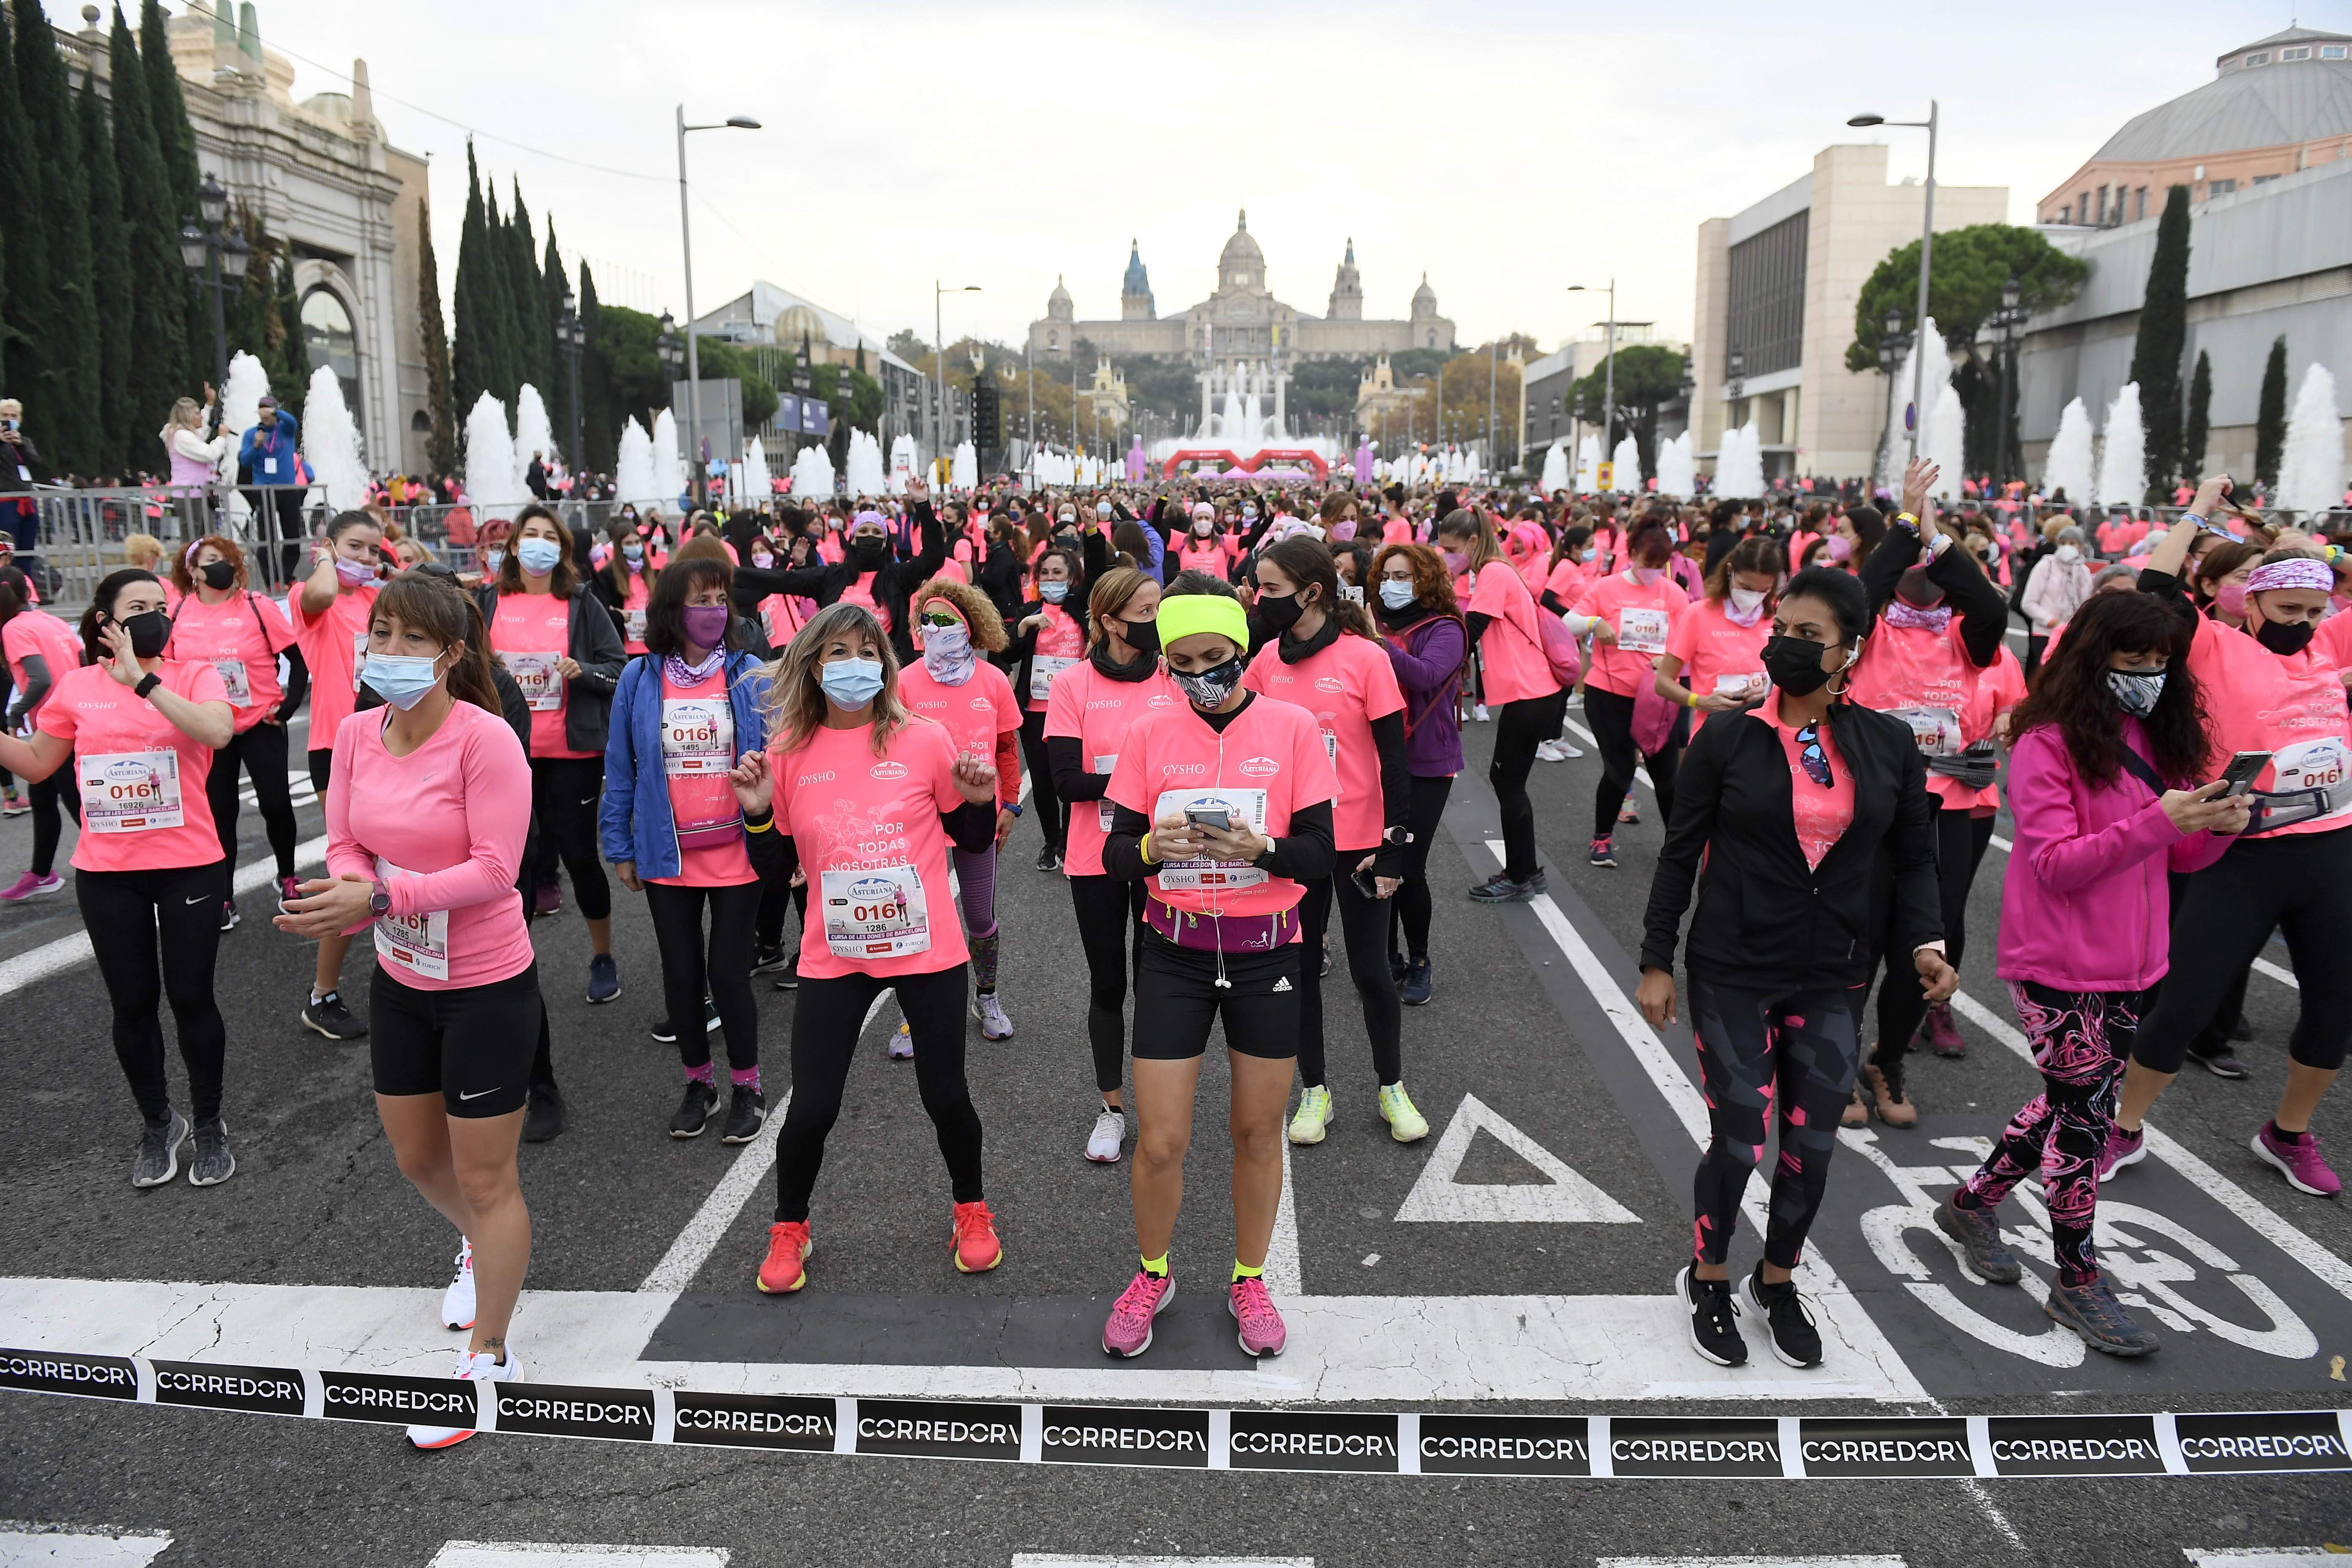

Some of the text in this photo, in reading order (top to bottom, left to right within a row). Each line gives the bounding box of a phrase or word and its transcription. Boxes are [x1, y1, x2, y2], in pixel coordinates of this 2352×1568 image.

[1636, 625, 1654, 634] 016
[514, 675, 542, 685] 016
[1271, 676, 1294, 684] OYSHO
[1317, 681, 1341, 690] ASTURIANA
[2325, 689, 2346, 699] PO
[78, 702, 117, 710] OYSHO
[916, 701, 947, 709] OYSHO
[1086, 700, 1122, 710] OYSHO
[2280, 717, 2342, 727] NOSOTRAS
[673, 728, 708, 741] 016
[1320, 728, 1334, 736] OR
[1916, 734, 1936, 746] 16
[971, 741, 988, 750] POR
[1163, 764, 1205, 775] OYSHO
[1243, 764, 1276, 772] ASTURIANA
[798, 770, 836, 787] OYSHO
[2304, 769, 2338, 787] 016
[110, 784, 150, 799] 016
[118, 801, 144, 809] 16926
[148, 806, 178, 814] BARCELONA
[875, 822, 904, 836] POR
[857, 838, 906, 855] TODAS
[830, 855, 907, 872] NOSOTRAS
[1163, 875, 1195, 883] OYSHO
[852, 887, 893, 896] ASTURIANA
[854, 903, 896, 921] 016
[866, 923, 887, 932] 1286
[894, 928, 926, 936] BARCELONA
[393, 926, 409, 940] 1285
[393, 936, 407, 947] DONES
[414, 946, 444, 959] BARCELONA
[422, 962, 441, 970] ZURICH
